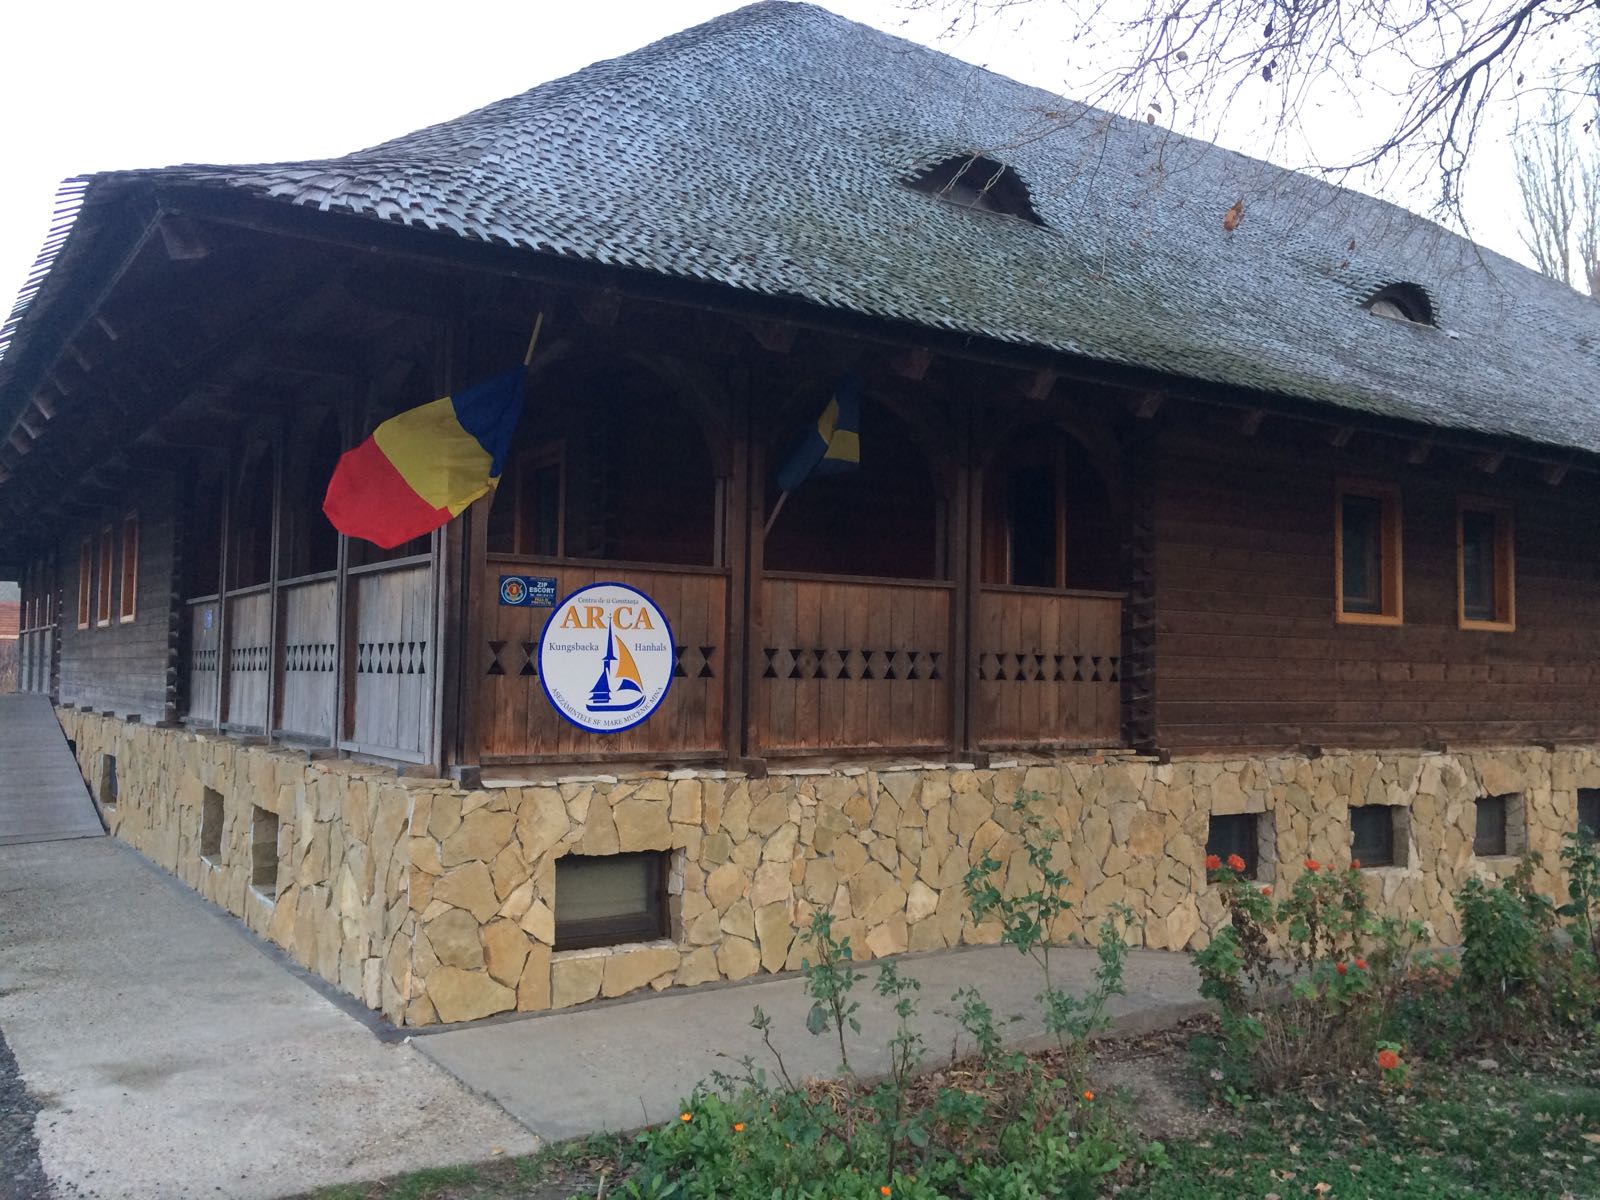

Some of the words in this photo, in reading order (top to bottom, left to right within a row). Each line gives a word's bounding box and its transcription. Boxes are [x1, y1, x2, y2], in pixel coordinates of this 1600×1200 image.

[560, 605, 655, 630] ARCA
[549, 642, 600, 653] Kungsbacka
[634, 643, 667, 652] Hanhals
